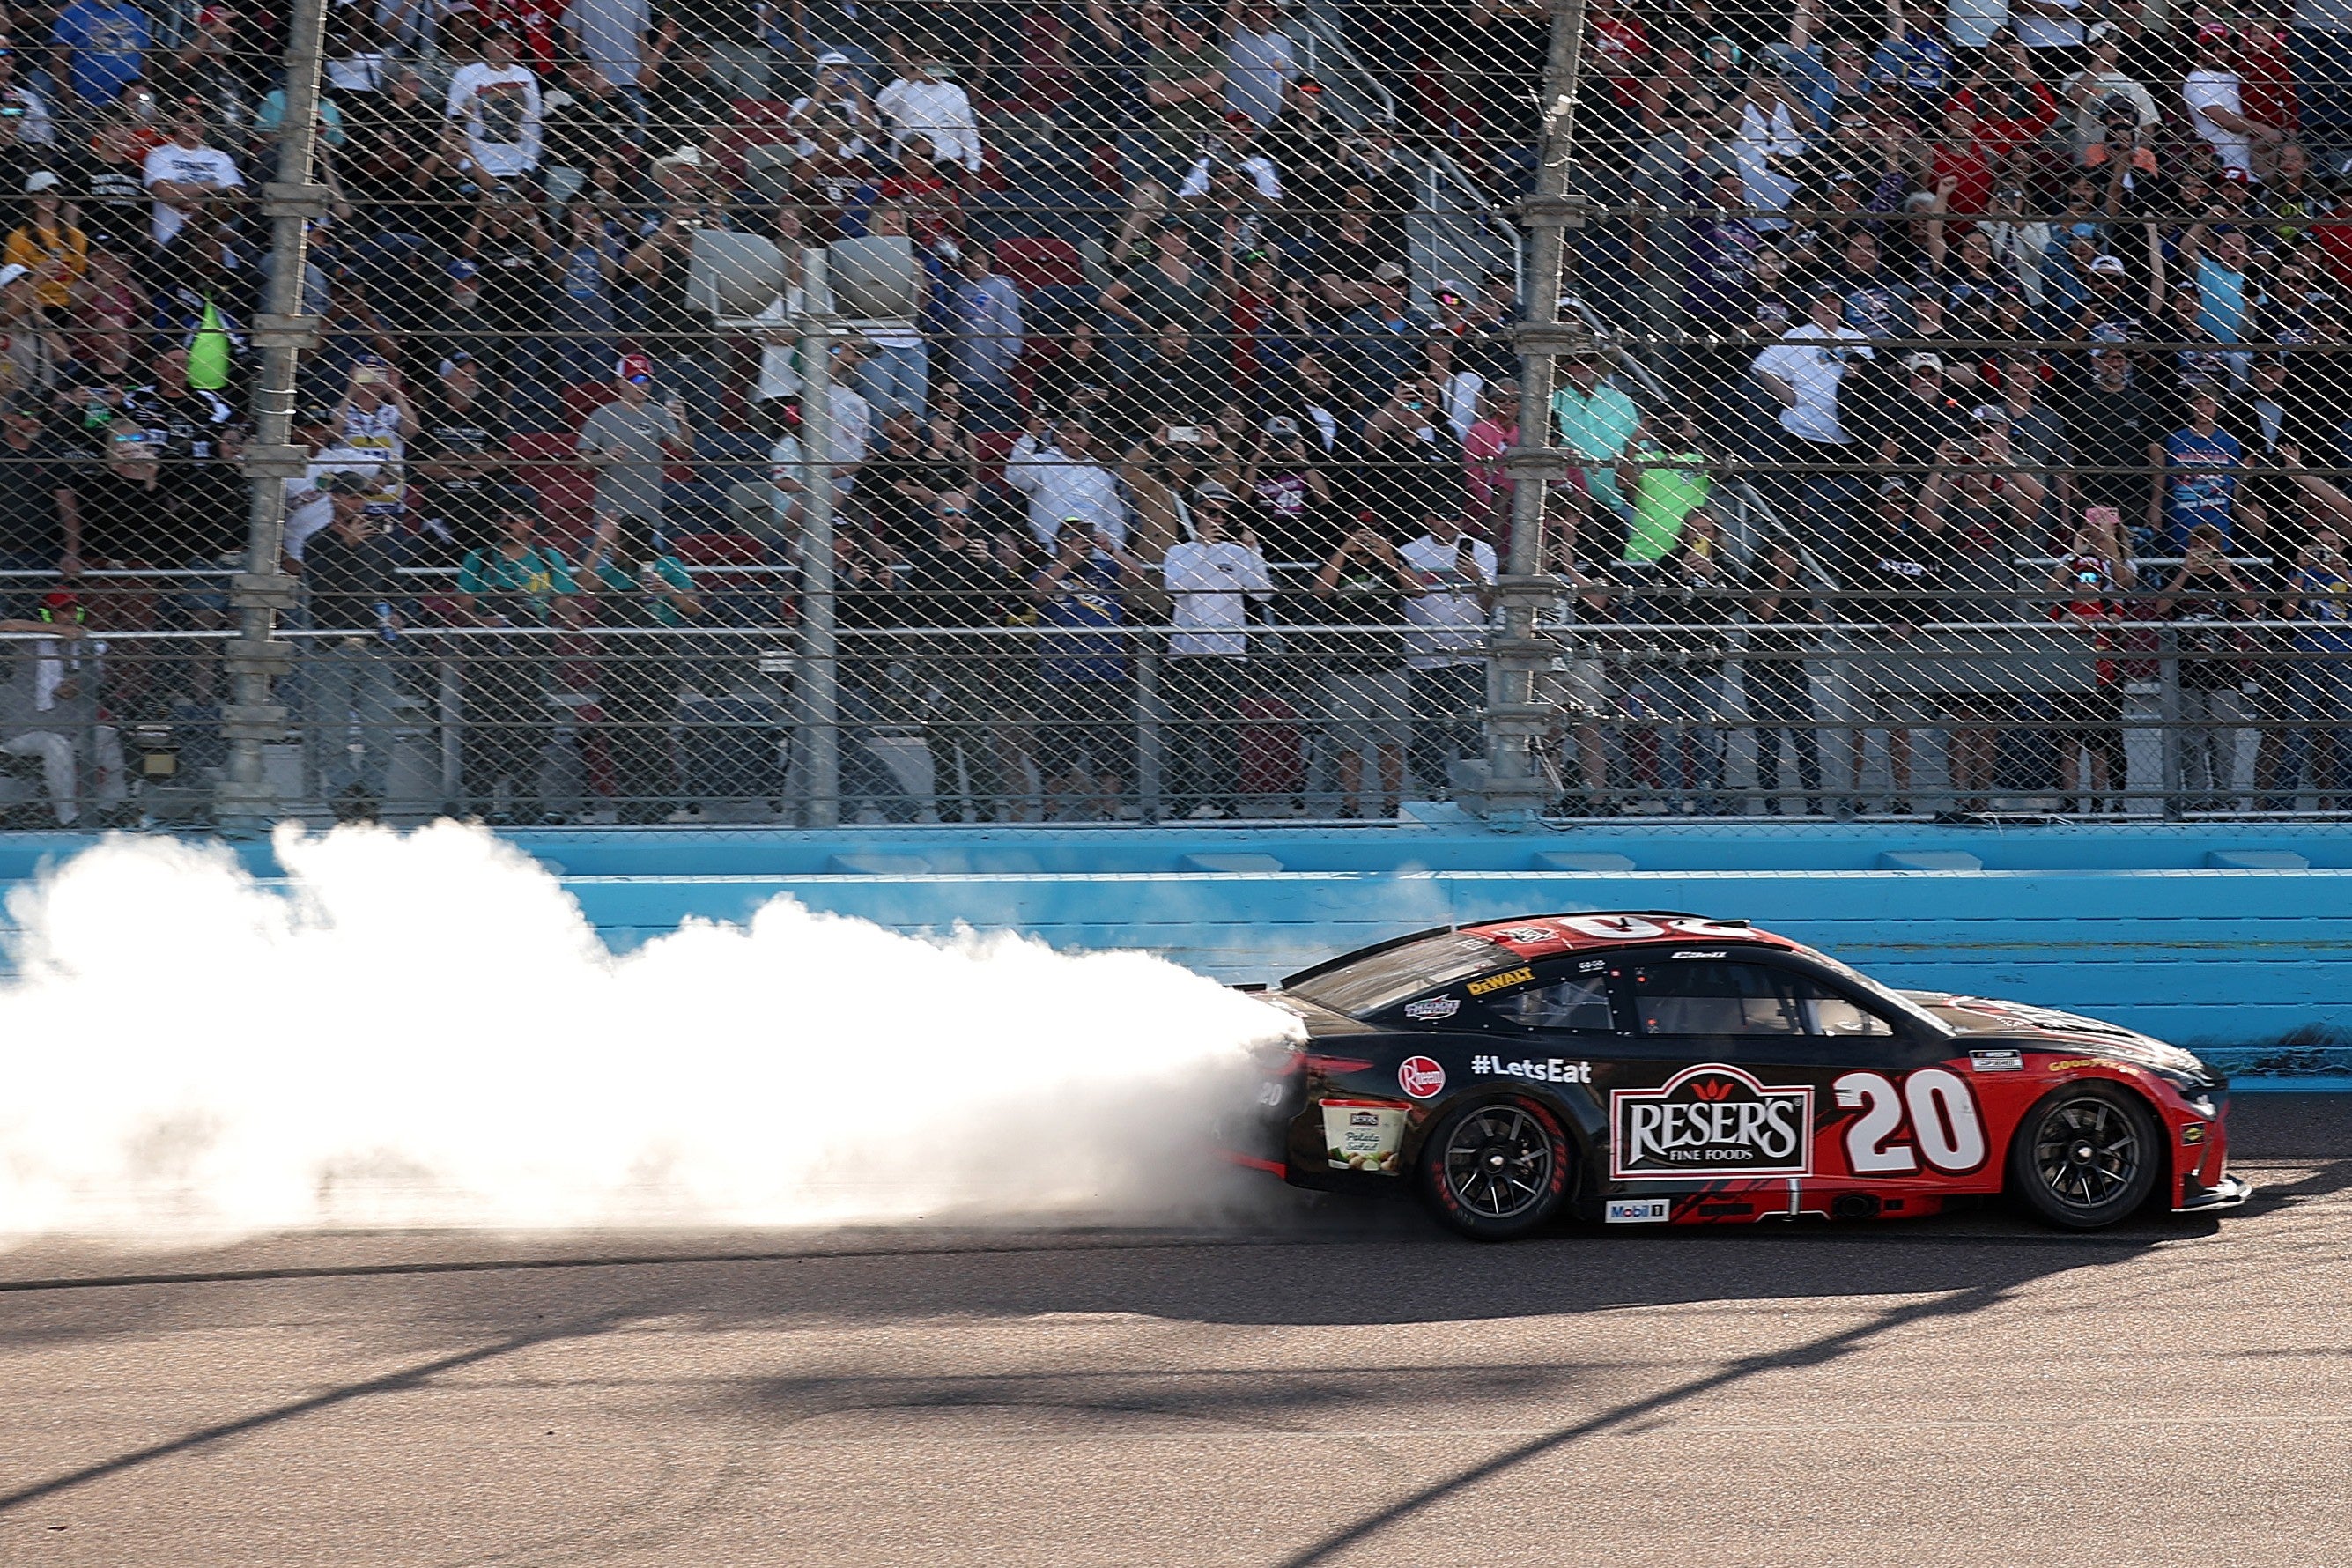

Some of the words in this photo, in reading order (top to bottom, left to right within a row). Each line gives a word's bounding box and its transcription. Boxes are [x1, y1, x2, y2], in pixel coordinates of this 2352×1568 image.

[1470, 1054, 1593, 1084] #LetsEat
[1628, 1097, 1797, 1165] RESER'S
[1832, 1069, 1985, 1172] 20
[1669, 1150, 1702, 1161] FINE
[1705, 1149, 1754, 1160] FOODS
[1610, 1205, 1649, 1218] Mobil
